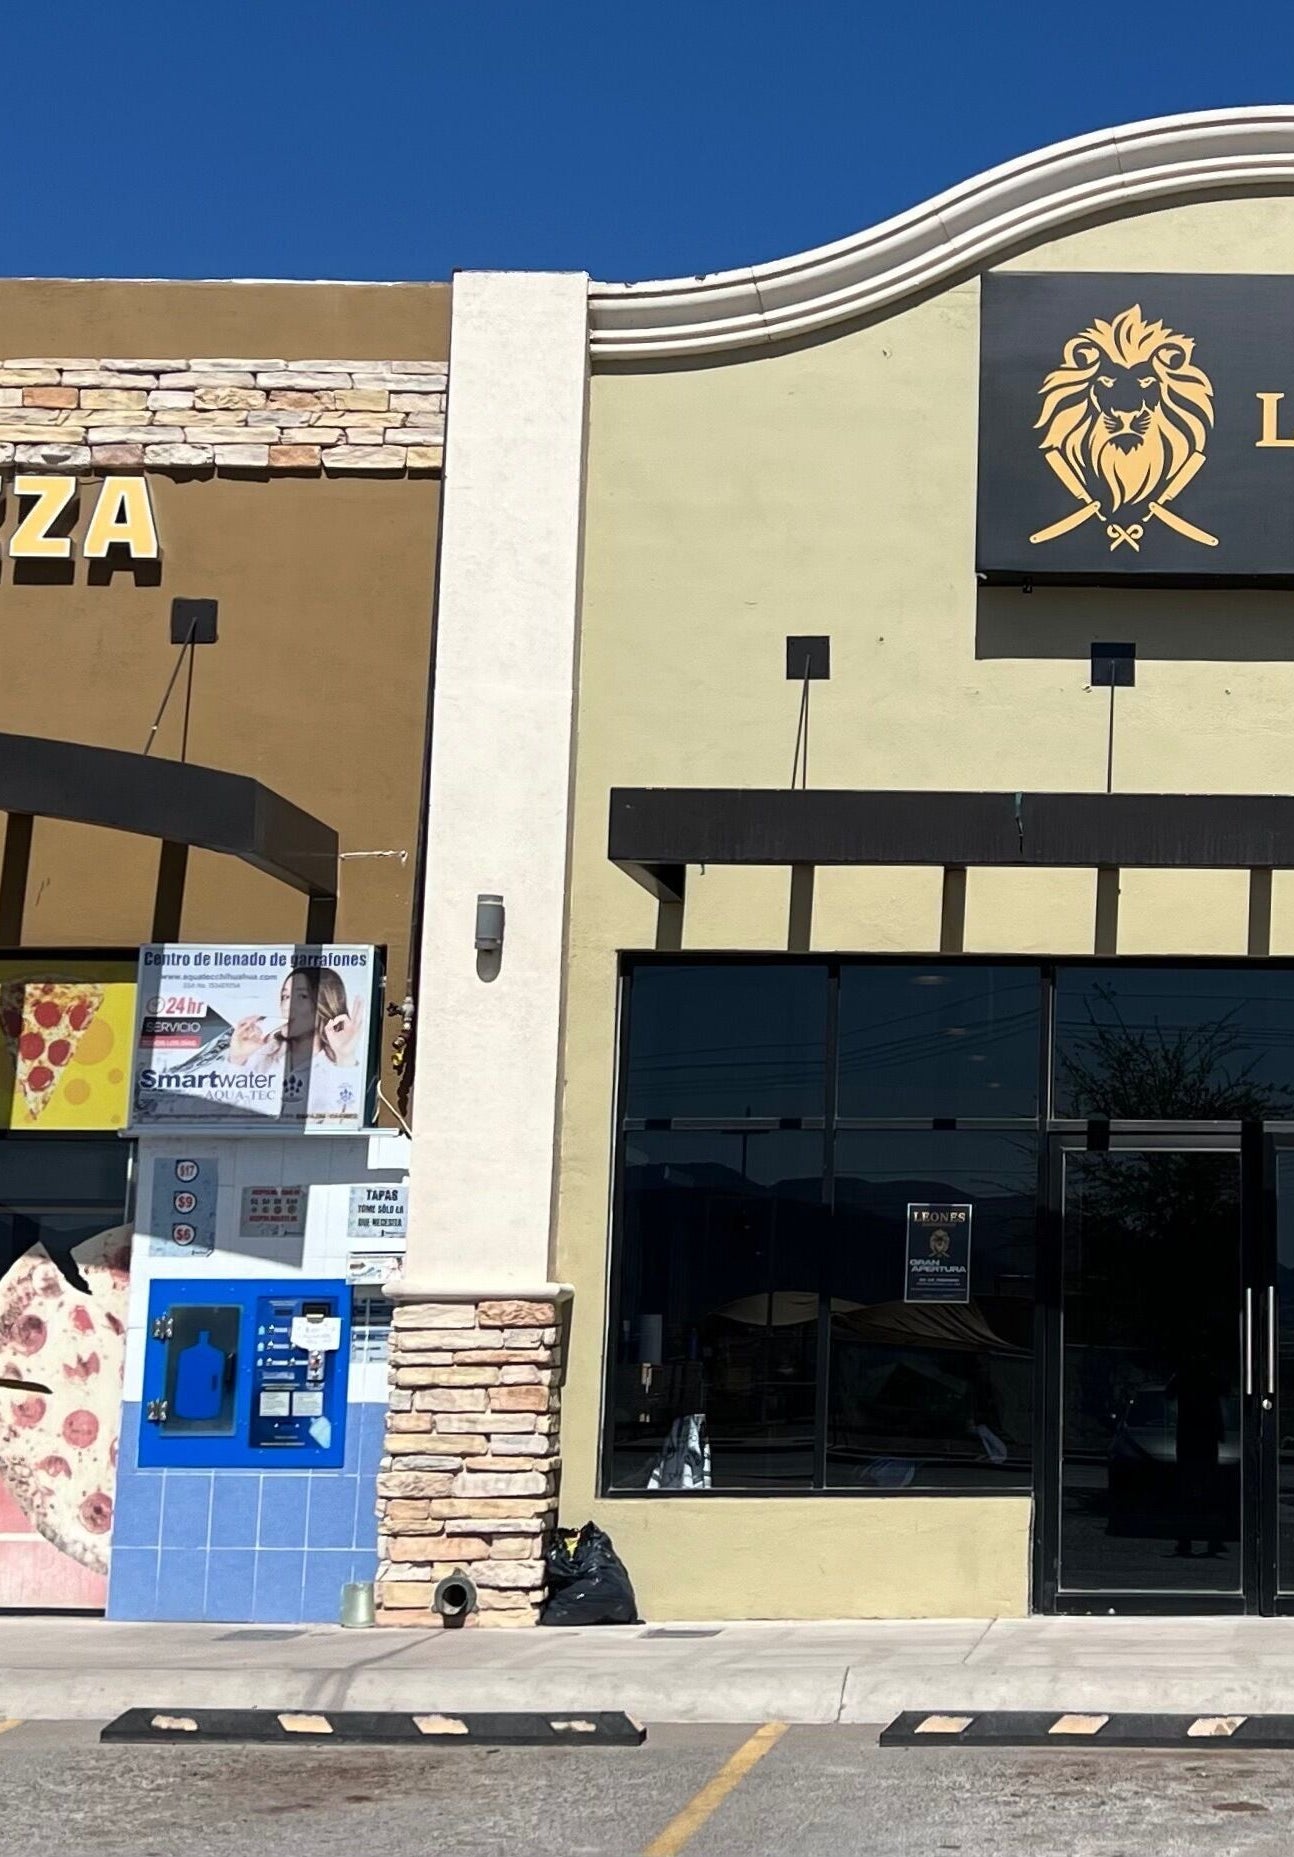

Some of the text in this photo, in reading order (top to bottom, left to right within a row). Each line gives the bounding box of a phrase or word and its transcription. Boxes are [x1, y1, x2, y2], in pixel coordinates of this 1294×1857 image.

[0, 475, 158, 558] ZA
[144, 951, 367, 968] Centro de llenado de garrafones
[166, 997, 204, 1014] 24 hr
[145, 1021, 201, 1033] SERVICIO
[140, 1069, 276, 1089] Smartwater
[205, 1090, 276, 1102] AQUA-TEC
[366, 1189, 399, 1202] TAPAS
[178, 1196, 193, 1208] $9
[913, 1211, 966, 1223] LEONES
[911, 1265, 967, 1273] APERTURA
